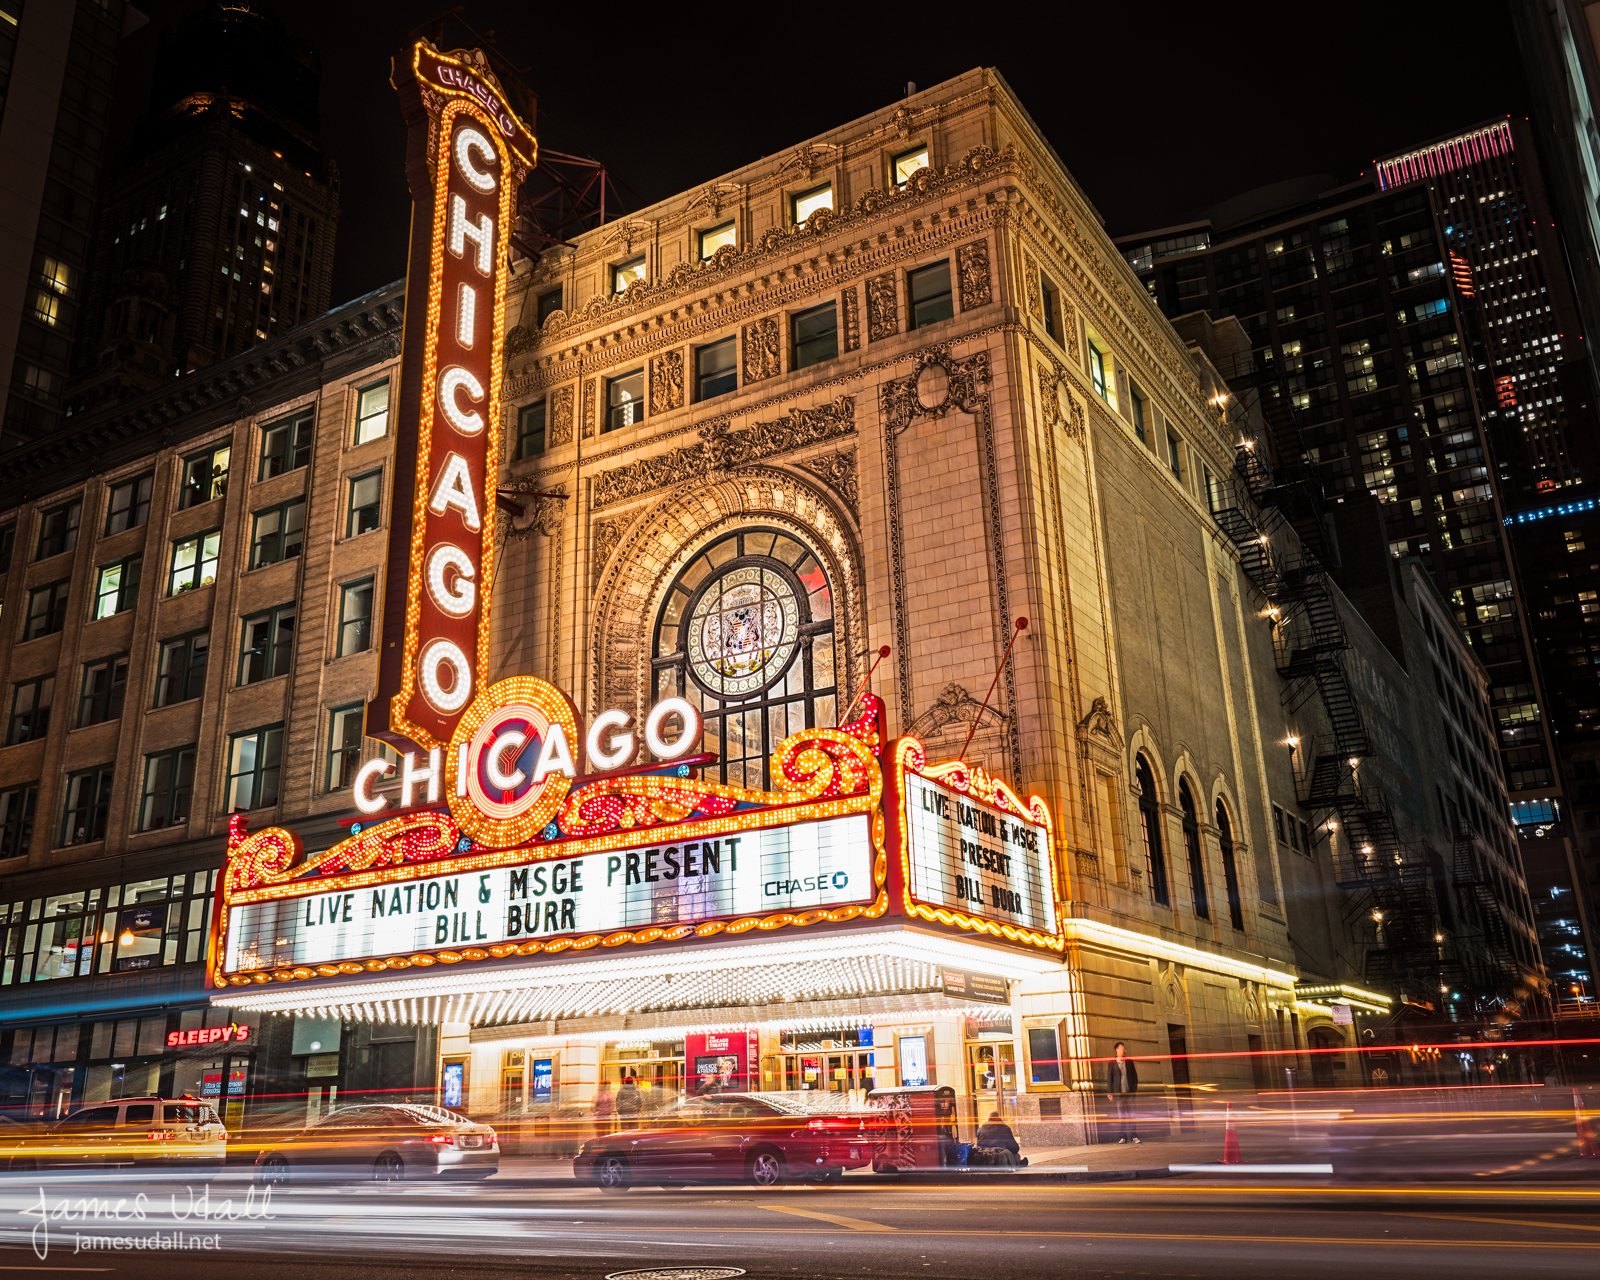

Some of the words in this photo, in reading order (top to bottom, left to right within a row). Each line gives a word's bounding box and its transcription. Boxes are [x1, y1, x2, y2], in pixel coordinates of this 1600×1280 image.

[438, 65, 500, 116] CHASE
[419, 127, 498, 712] CHICAGO
[354, 696, 700, 814] CHICAGO
[922, 786, 950, 820] LIVE
[956, 800, 997, 838] NATION
[999, 818, 1009, 842] &
[1011, 822, 1039, 853] MSGE
[306, 893, 353, 927] LIVE
[372, 878, 459, 919] NATION
[478, 873, 492, 904] &
[509, 859, 583, 901] MSGE
[607, 836, 741, 887] PRESENT
[960, 838, 1011, 878] PRESENT
[764, 874, 828, 897] CHASE
[956, 874, 984, 905] BILL
[991, 884, 1023, 915] BURR
[435, 911, 488, 945] BILL
[507, 898, 576, 937] BURR
[168, 1022, 249, 1047] SLEEPY'S
